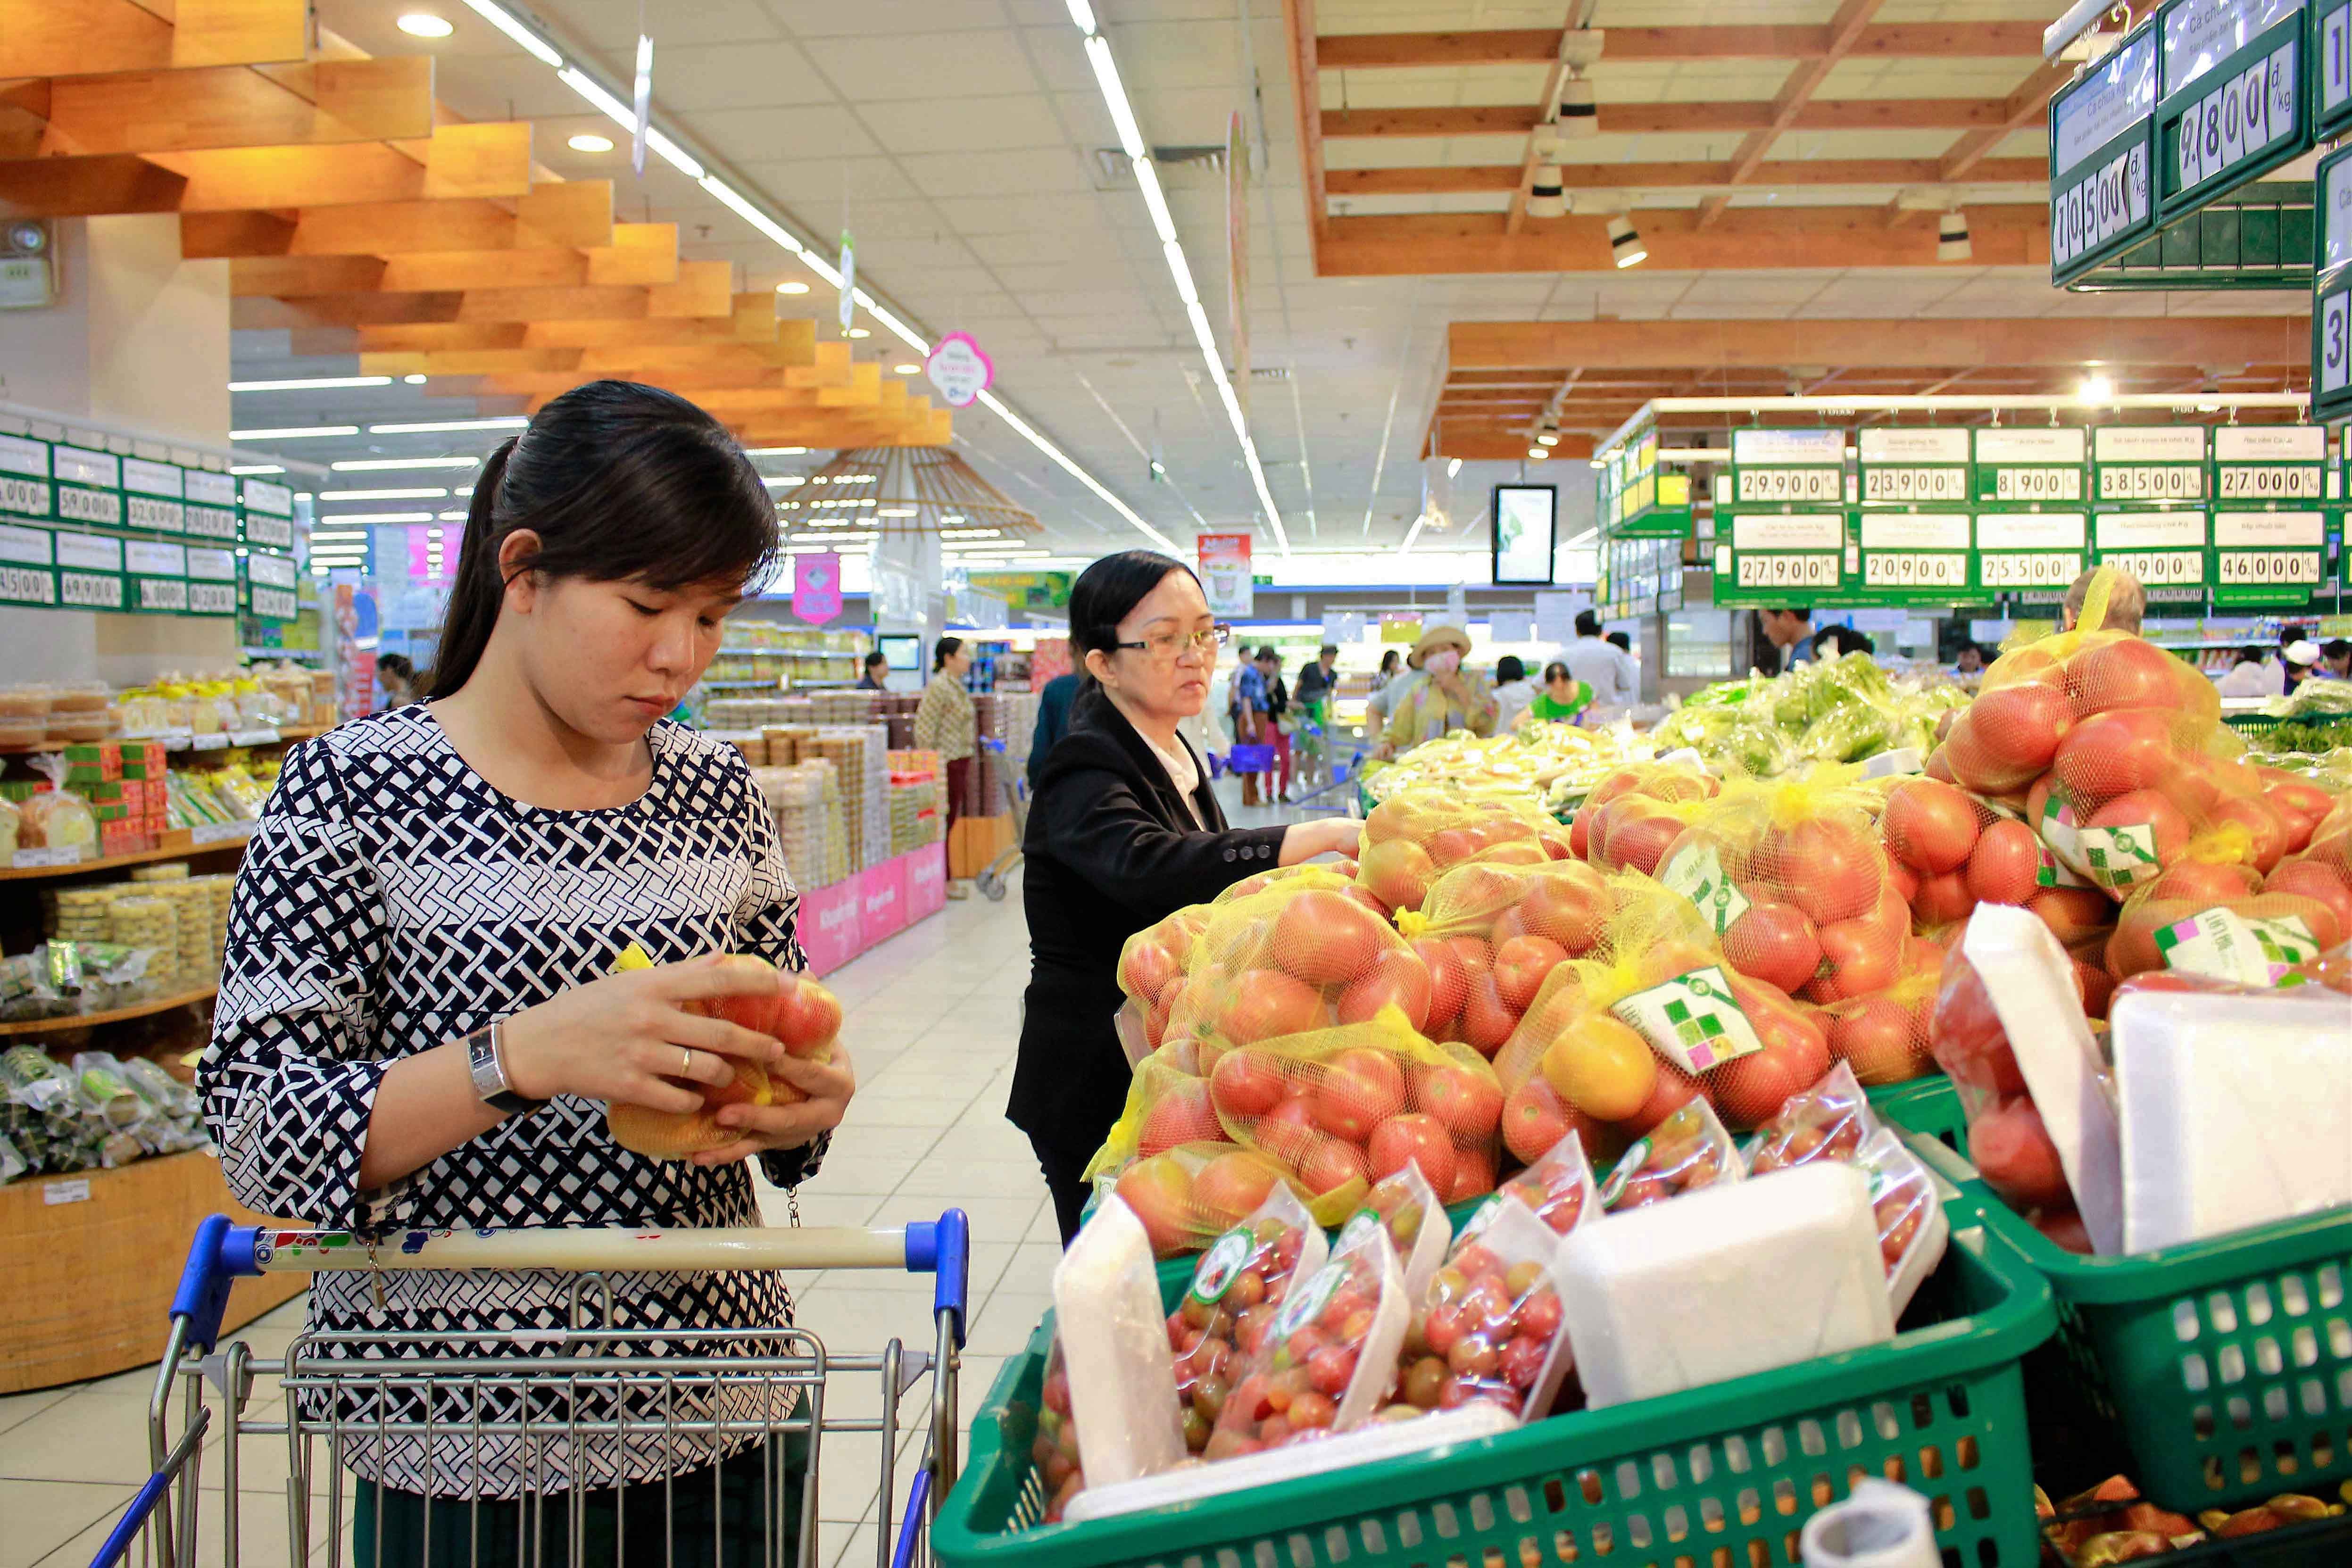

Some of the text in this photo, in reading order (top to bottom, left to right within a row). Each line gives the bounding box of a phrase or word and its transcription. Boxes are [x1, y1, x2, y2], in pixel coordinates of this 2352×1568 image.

[2180, 74, 2260, 171] 9.800
[2056, 172, 2119, 250] 10.500
[2327, 308, 2344, 370] 3
[1744, 475, 1820, 494] 29.900
[1869, 475, 1945, 493] 23.900
[2103, 472, 2181, 492] 38.500
[2224, 472, 2300, 491] 27.000
[1743, 561, 1819, 580] 27.900
[1870, 558, 1946, 578] 20.900
[2223, 557, 2301, 577] 46.000
